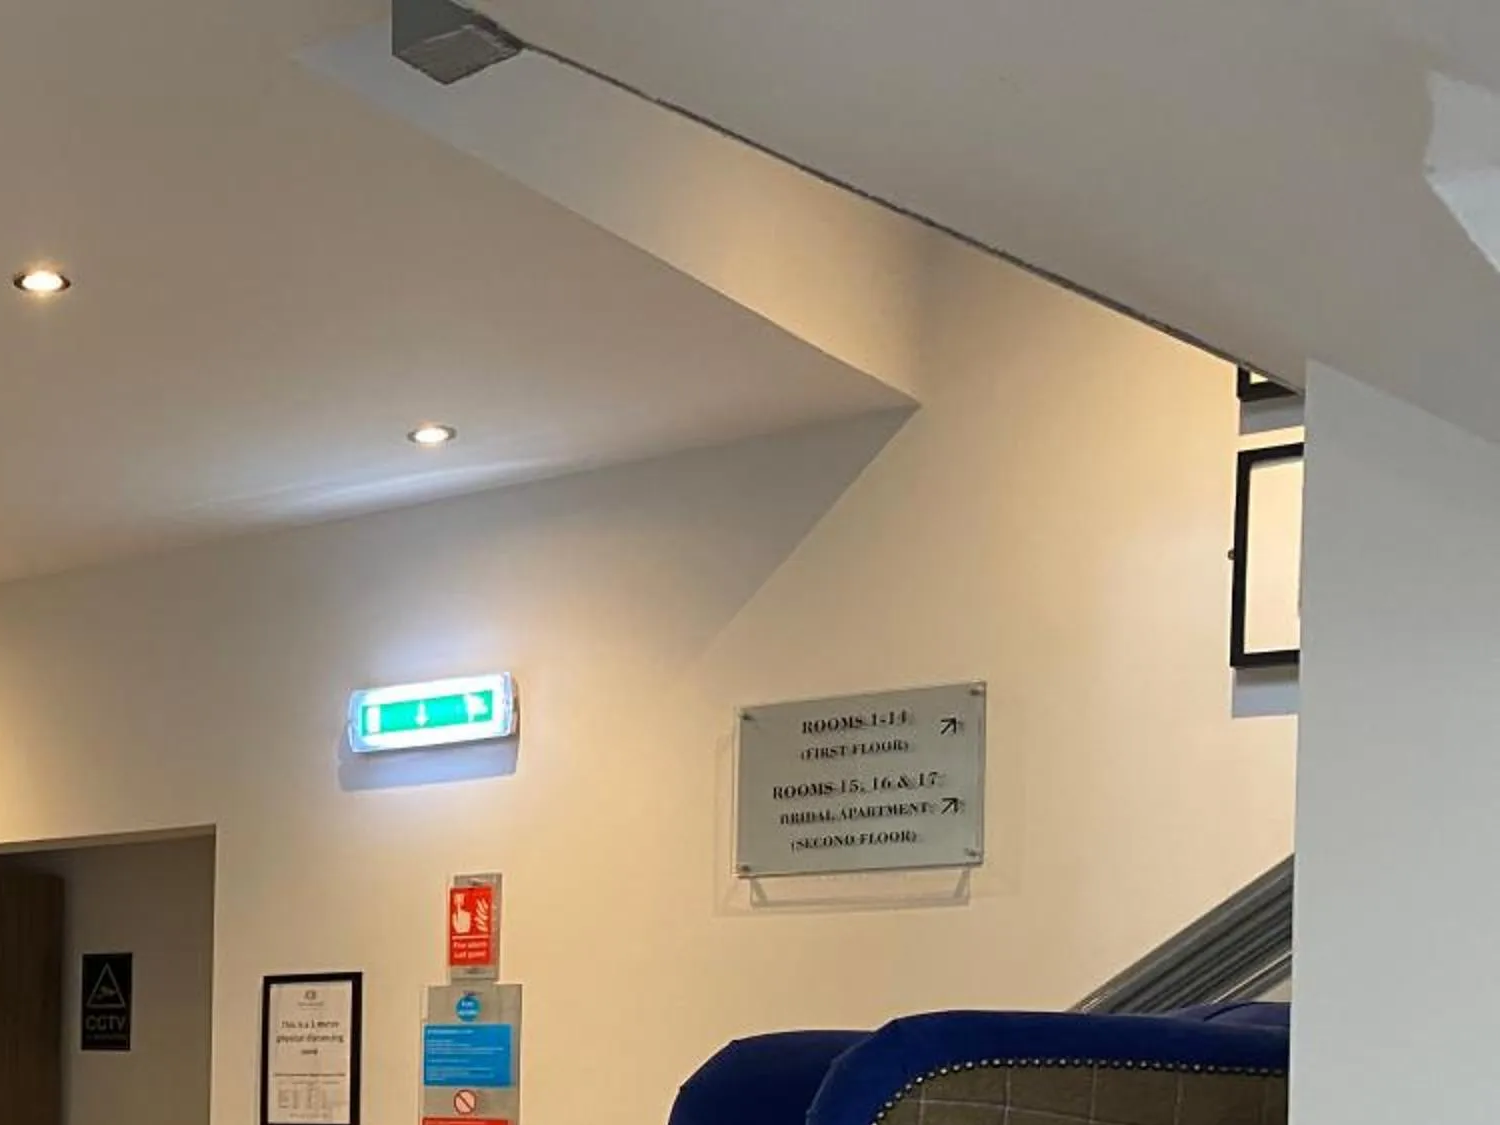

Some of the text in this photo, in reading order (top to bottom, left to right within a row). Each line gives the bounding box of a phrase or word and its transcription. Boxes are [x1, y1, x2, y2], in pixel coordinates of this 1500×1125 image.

[802, 709, 909, 734] ROOMS 1-14
[801, 739, 909, 760] (FIRST FLOOR)
[773, 782, 834, 800] ROOMS
[872, 776, 892, 790] 16
[897, 775, 910, 788] &
[918, 771, 939, 787] 17
[840, 801, 930, 820] APARTMENT
[791, 829, 918, 852] (SECOND FLOOR)
[85, 1014, 127, 1031] CCTV
